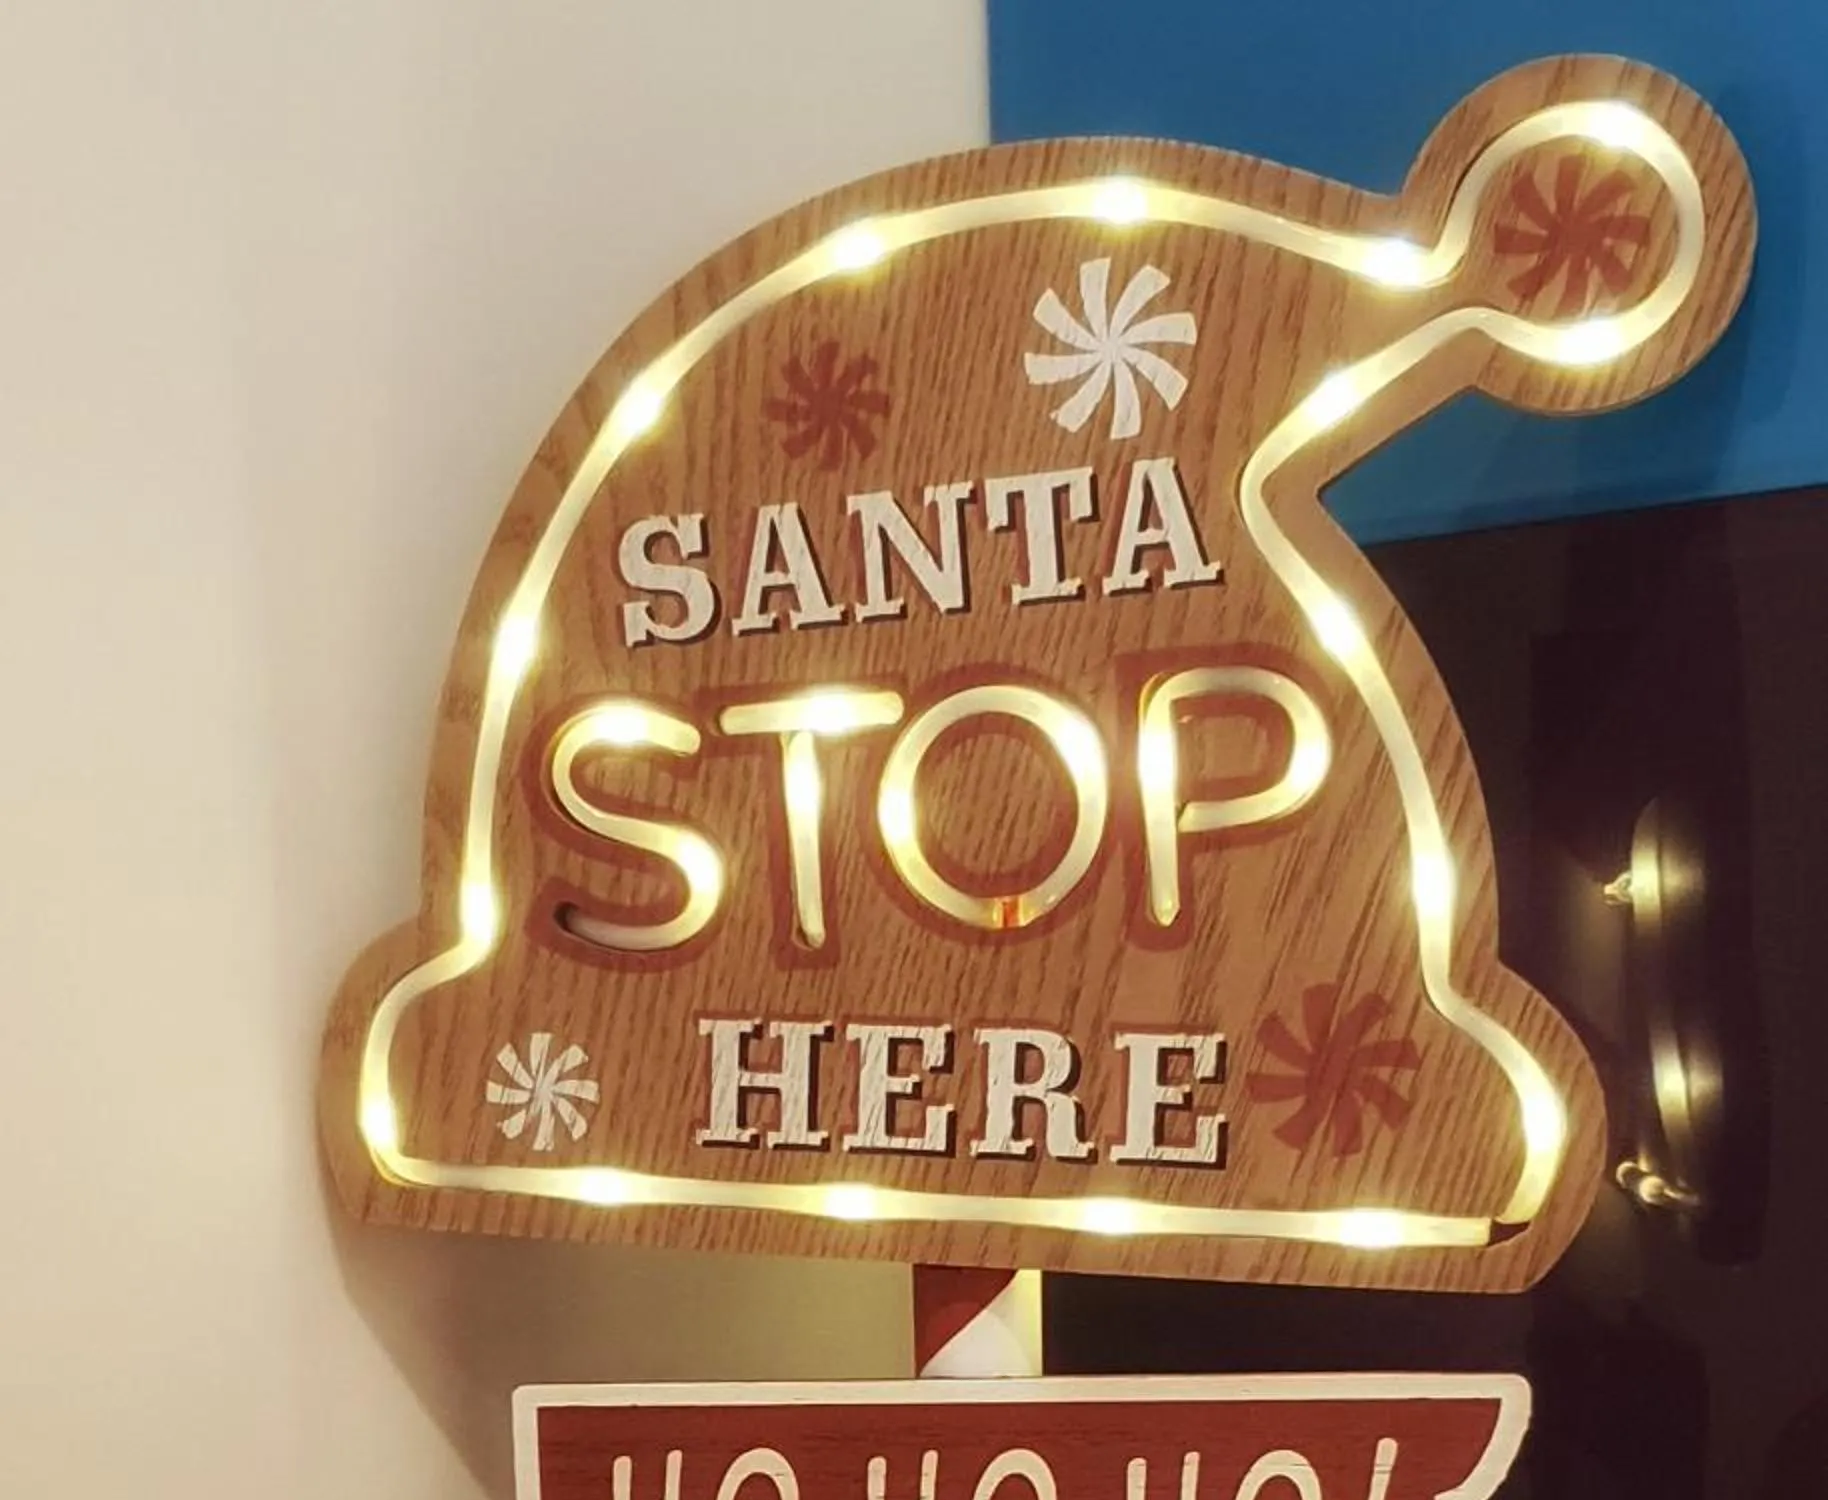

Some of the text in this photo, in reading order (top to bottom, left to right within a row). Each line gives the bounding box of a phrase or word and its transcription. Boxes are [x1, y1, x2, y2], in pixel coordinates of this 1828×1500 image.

[618, 456, 1222, 647] SANTA
[550, 666, 1332, 952] STOP
[697, 1018, 1228, 1167] HERE
